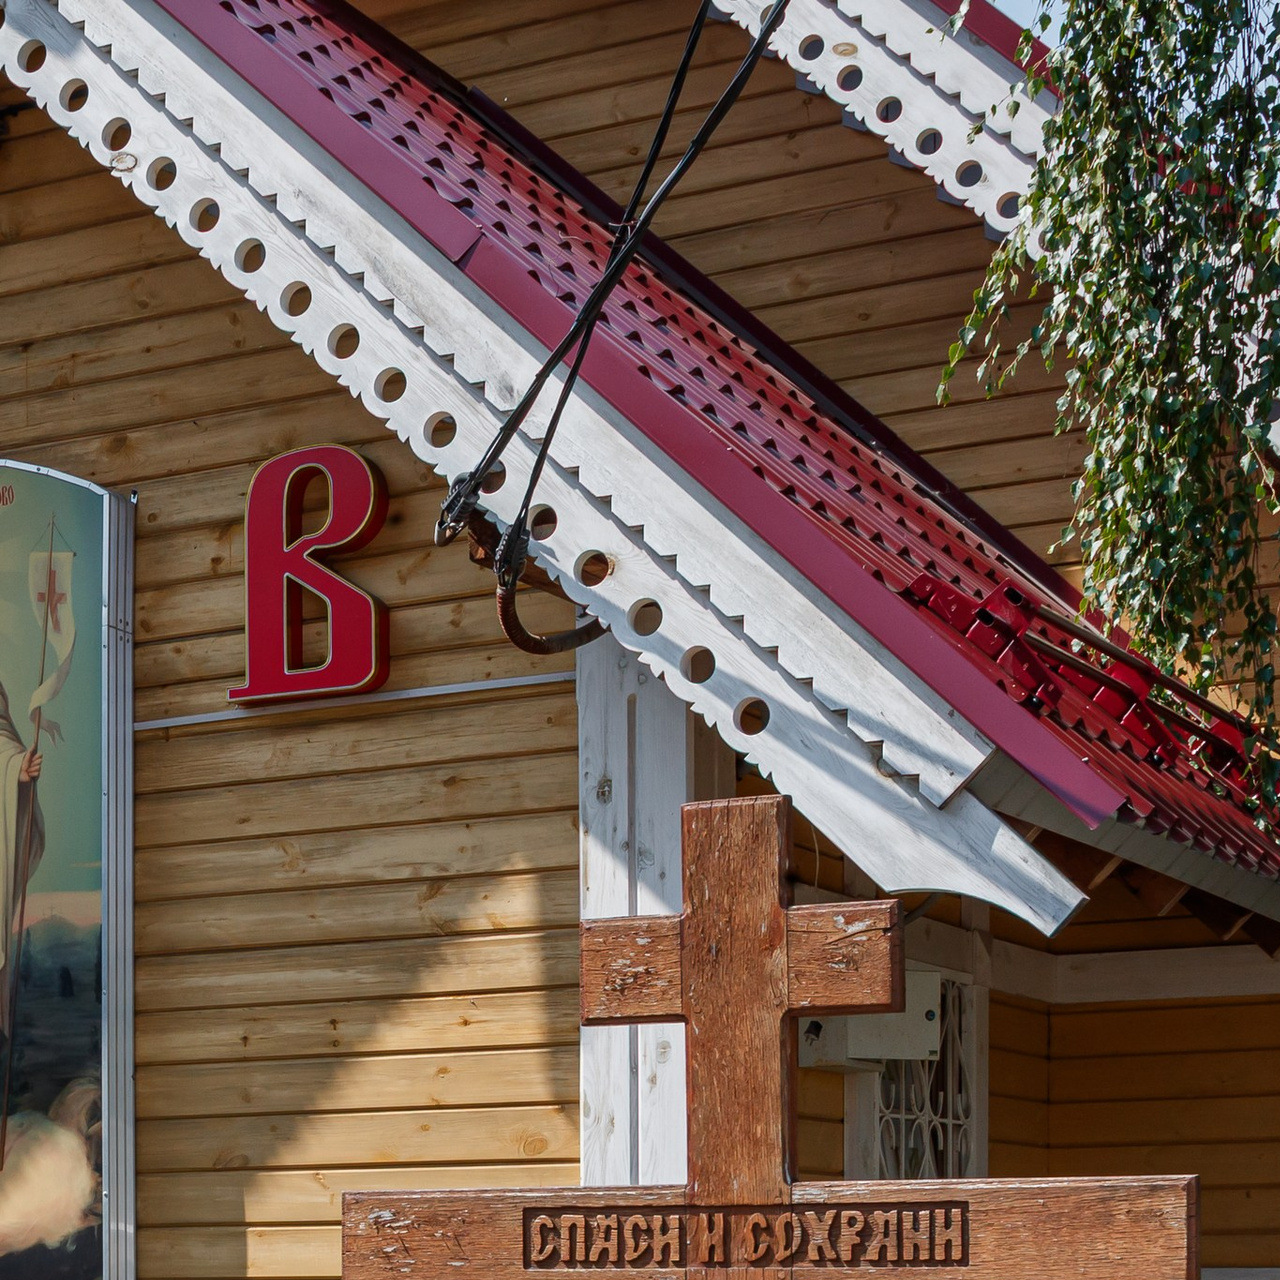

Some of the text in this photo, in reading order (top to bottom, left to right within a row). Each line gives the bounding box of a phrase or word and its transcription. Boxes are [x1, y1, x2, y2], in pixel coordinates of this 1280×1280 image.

[227, 443, 382, 703] В
[530, 1207, 963, 1265] СПАСИ И СОХРАНИ
